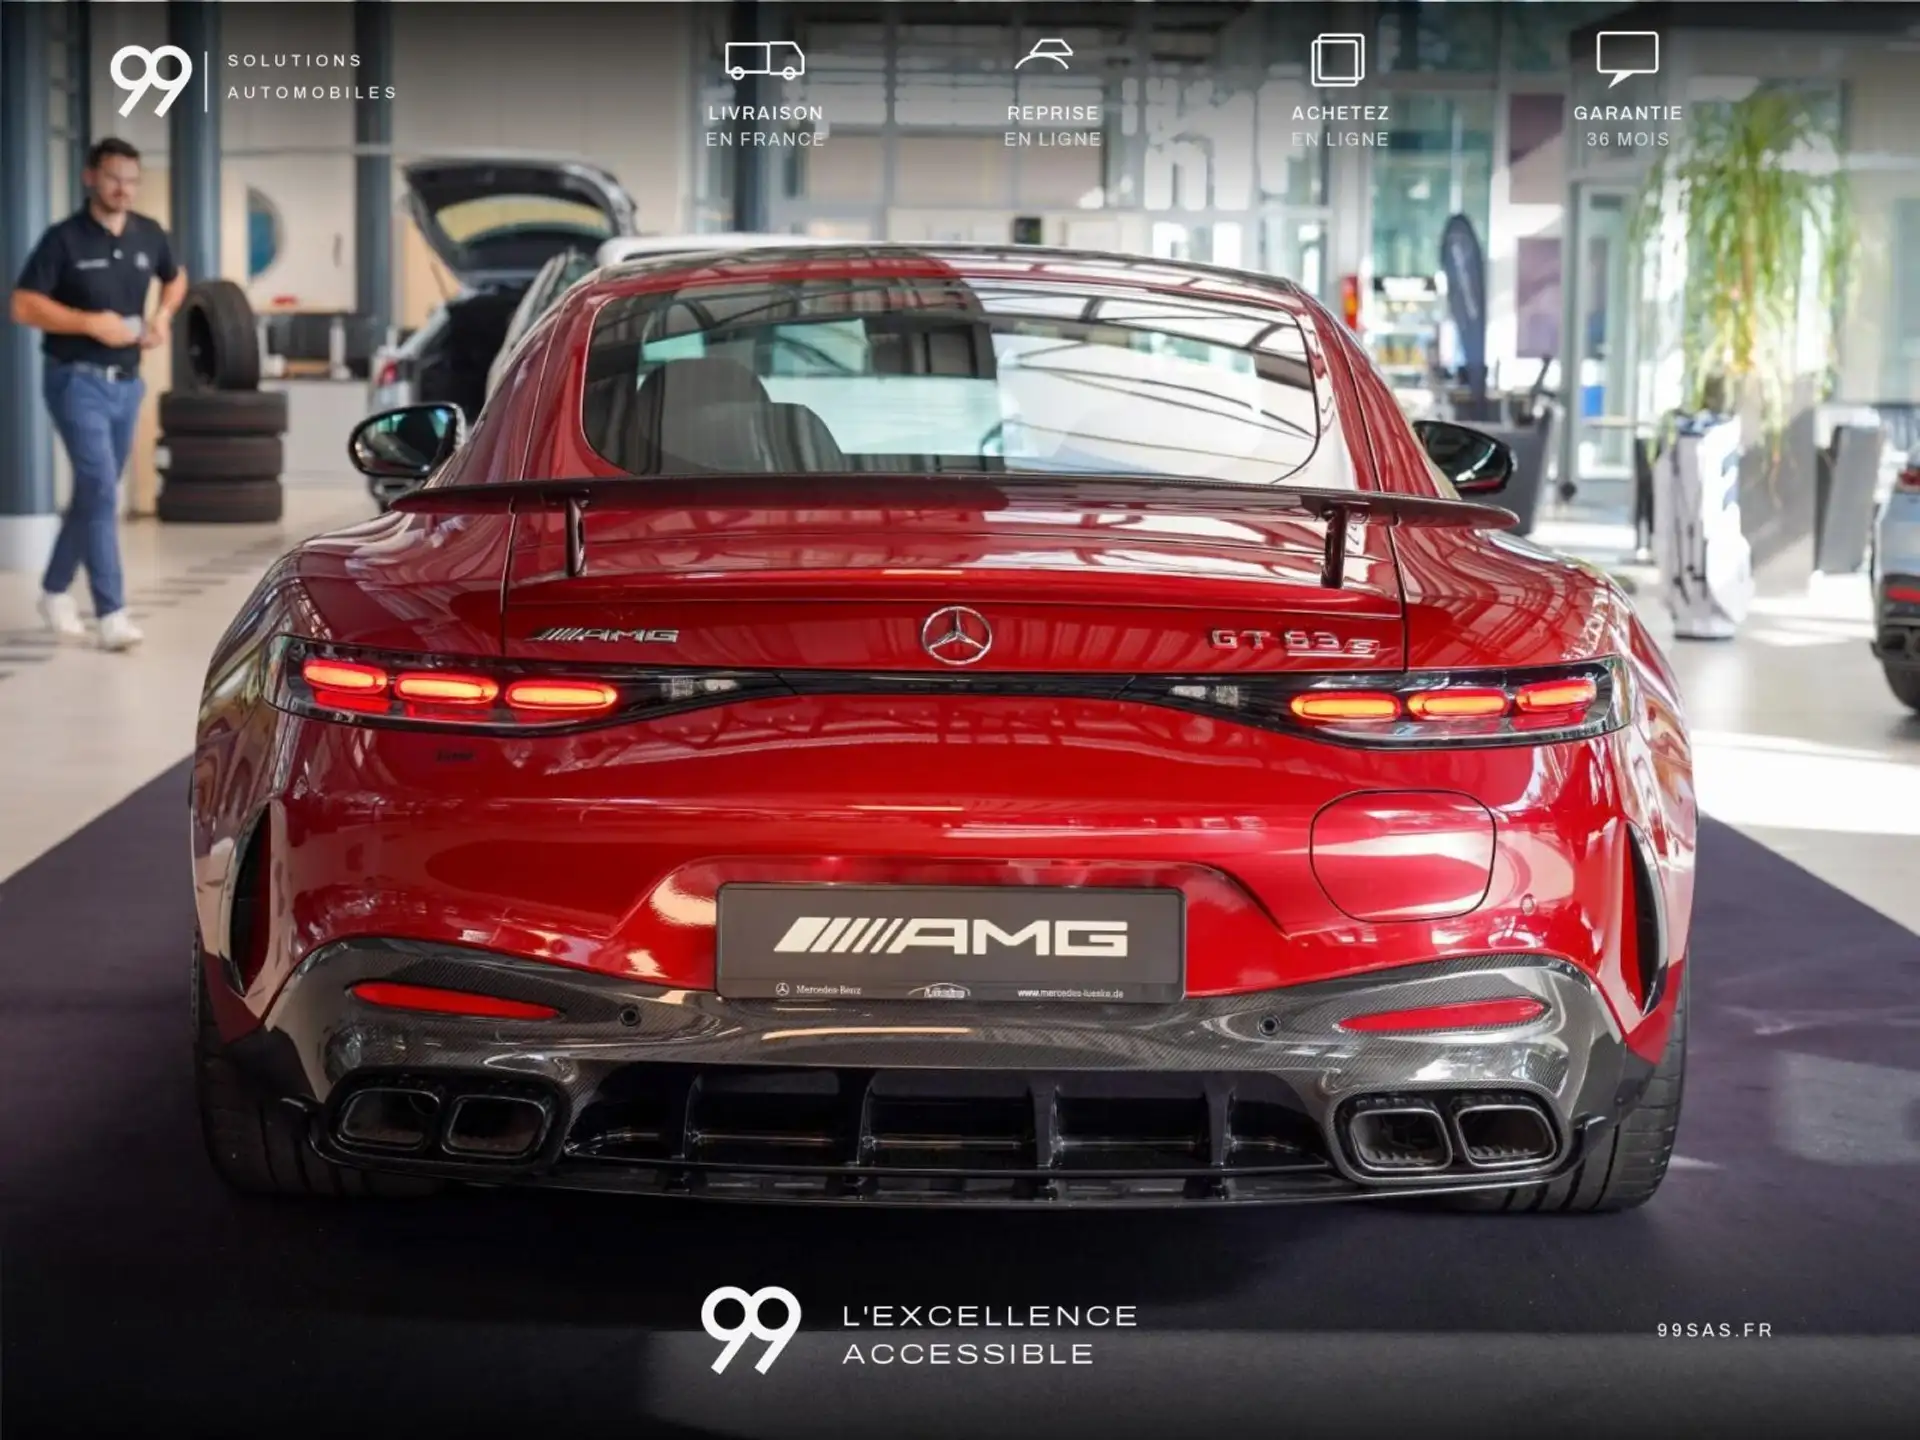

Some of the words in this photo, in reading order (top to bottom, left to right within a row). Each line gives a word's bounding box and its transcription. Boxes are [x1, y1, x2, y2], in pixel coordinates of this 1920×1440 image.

[1211, 629, 1271, 650] GT
[885, 918, 1129, 957] AMG
[796, 984, 862, 996] Mercedes-Benz
